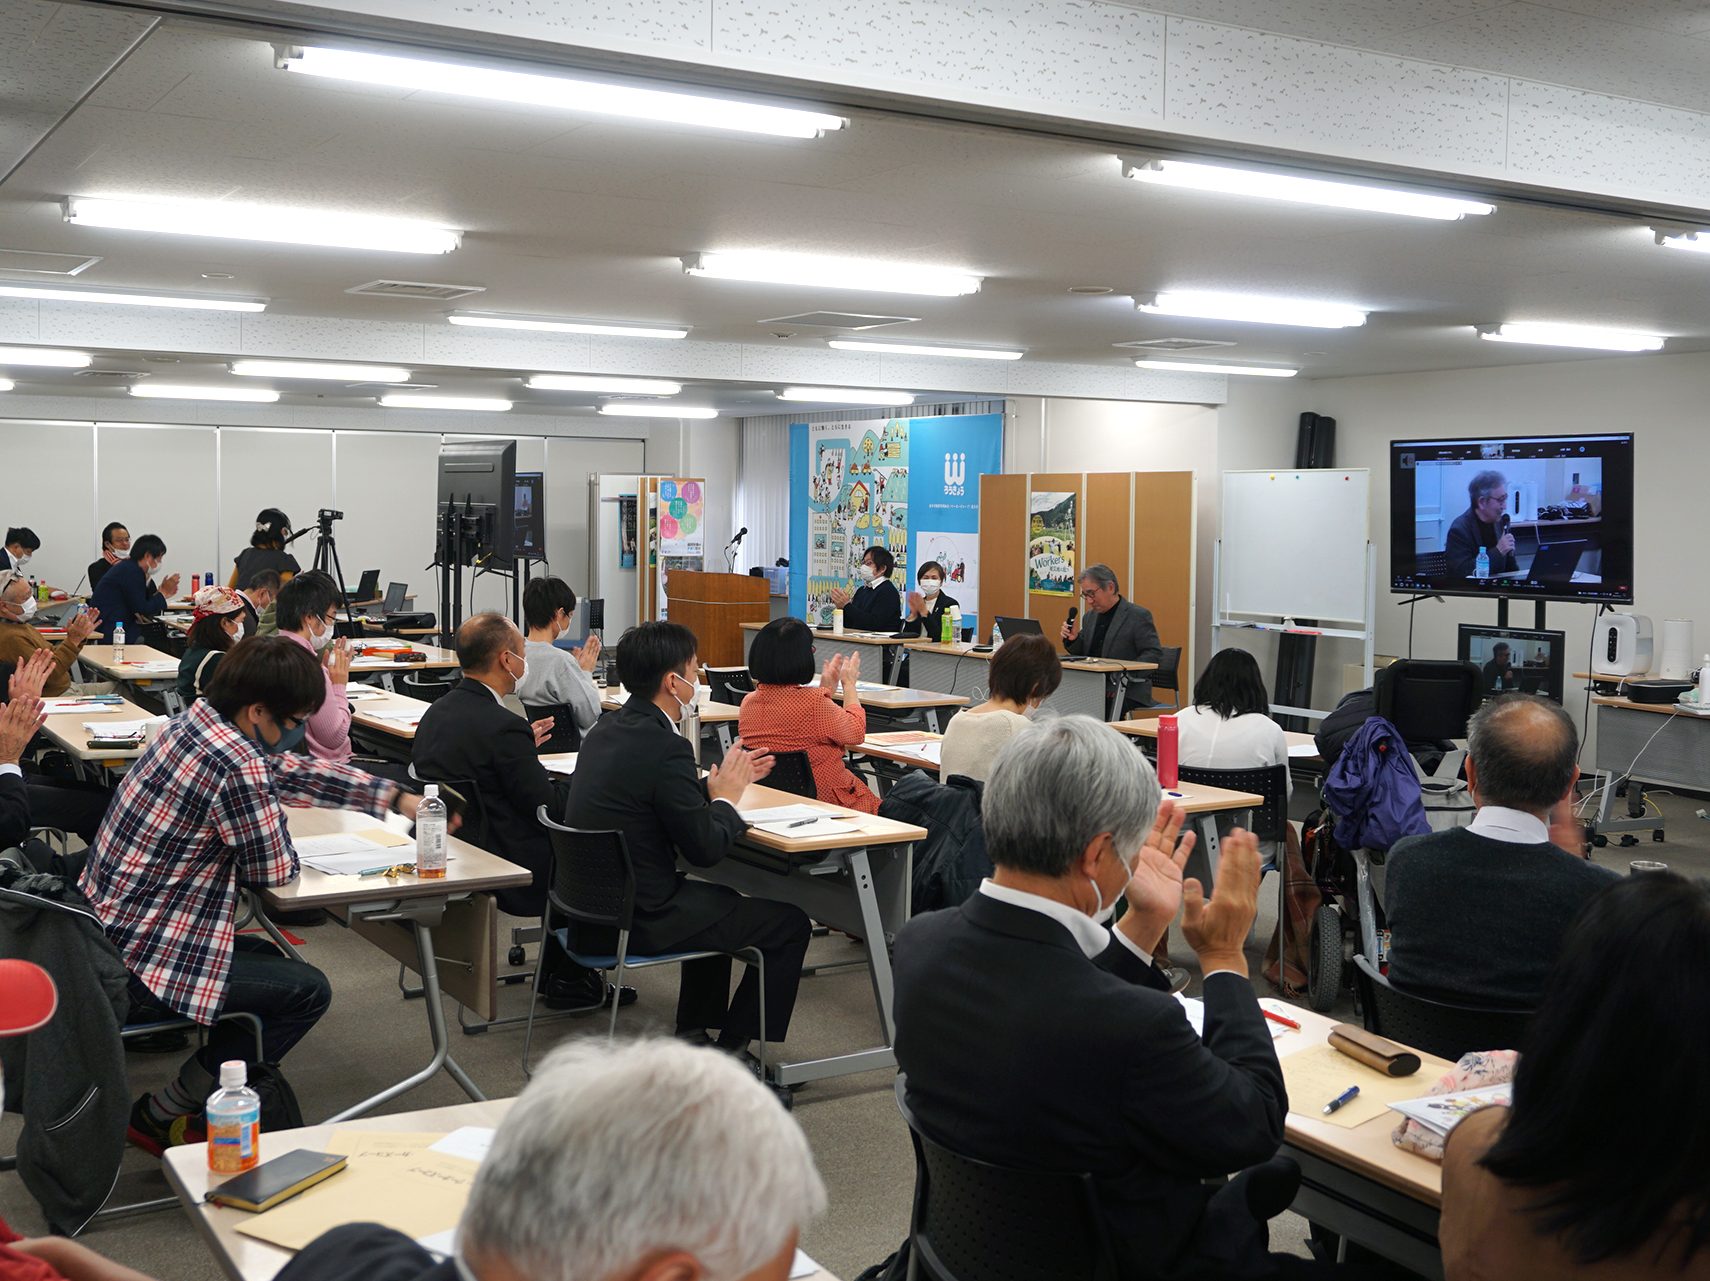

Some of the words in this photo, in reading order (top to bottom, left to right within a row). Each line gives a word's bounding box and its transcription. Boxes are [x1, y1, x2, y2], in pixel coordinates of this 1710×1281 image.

[944, 485, 965, 496] ろうきょう
[1035, 555, 1065, 569] Workers
